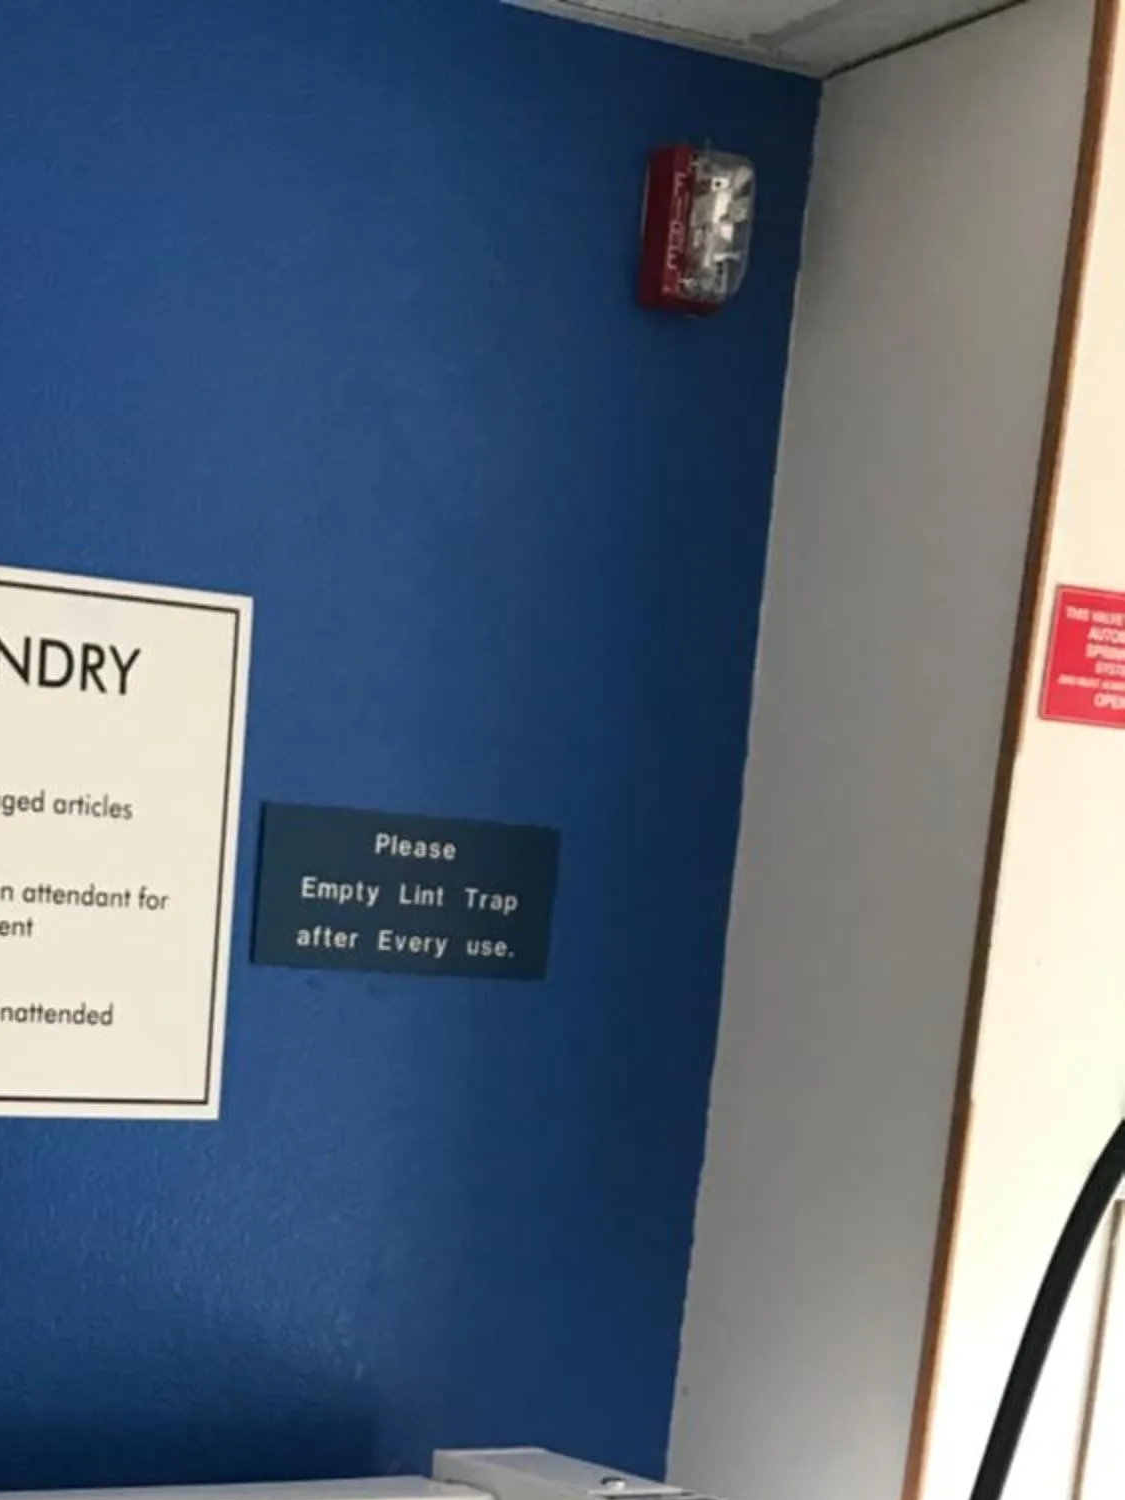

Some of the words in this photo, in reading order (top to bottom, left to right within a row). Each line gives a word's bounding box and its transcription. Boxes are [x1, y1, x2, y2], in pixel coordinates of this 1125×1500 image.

[53, 794, 133, 820] articles
[375, 833, 455, 860] Please
[22, 883, 131, 908] attendant
[138, 886, 169, 911] for
[301, 876, 379, 906] Empty
[399, 883, 443, 906] Lint
[465, 888, 518, 915] Trap
[297, 926, 358, 948] after
[378, 930, 447, 958] Every
[467, 940, 513, 957] use.
